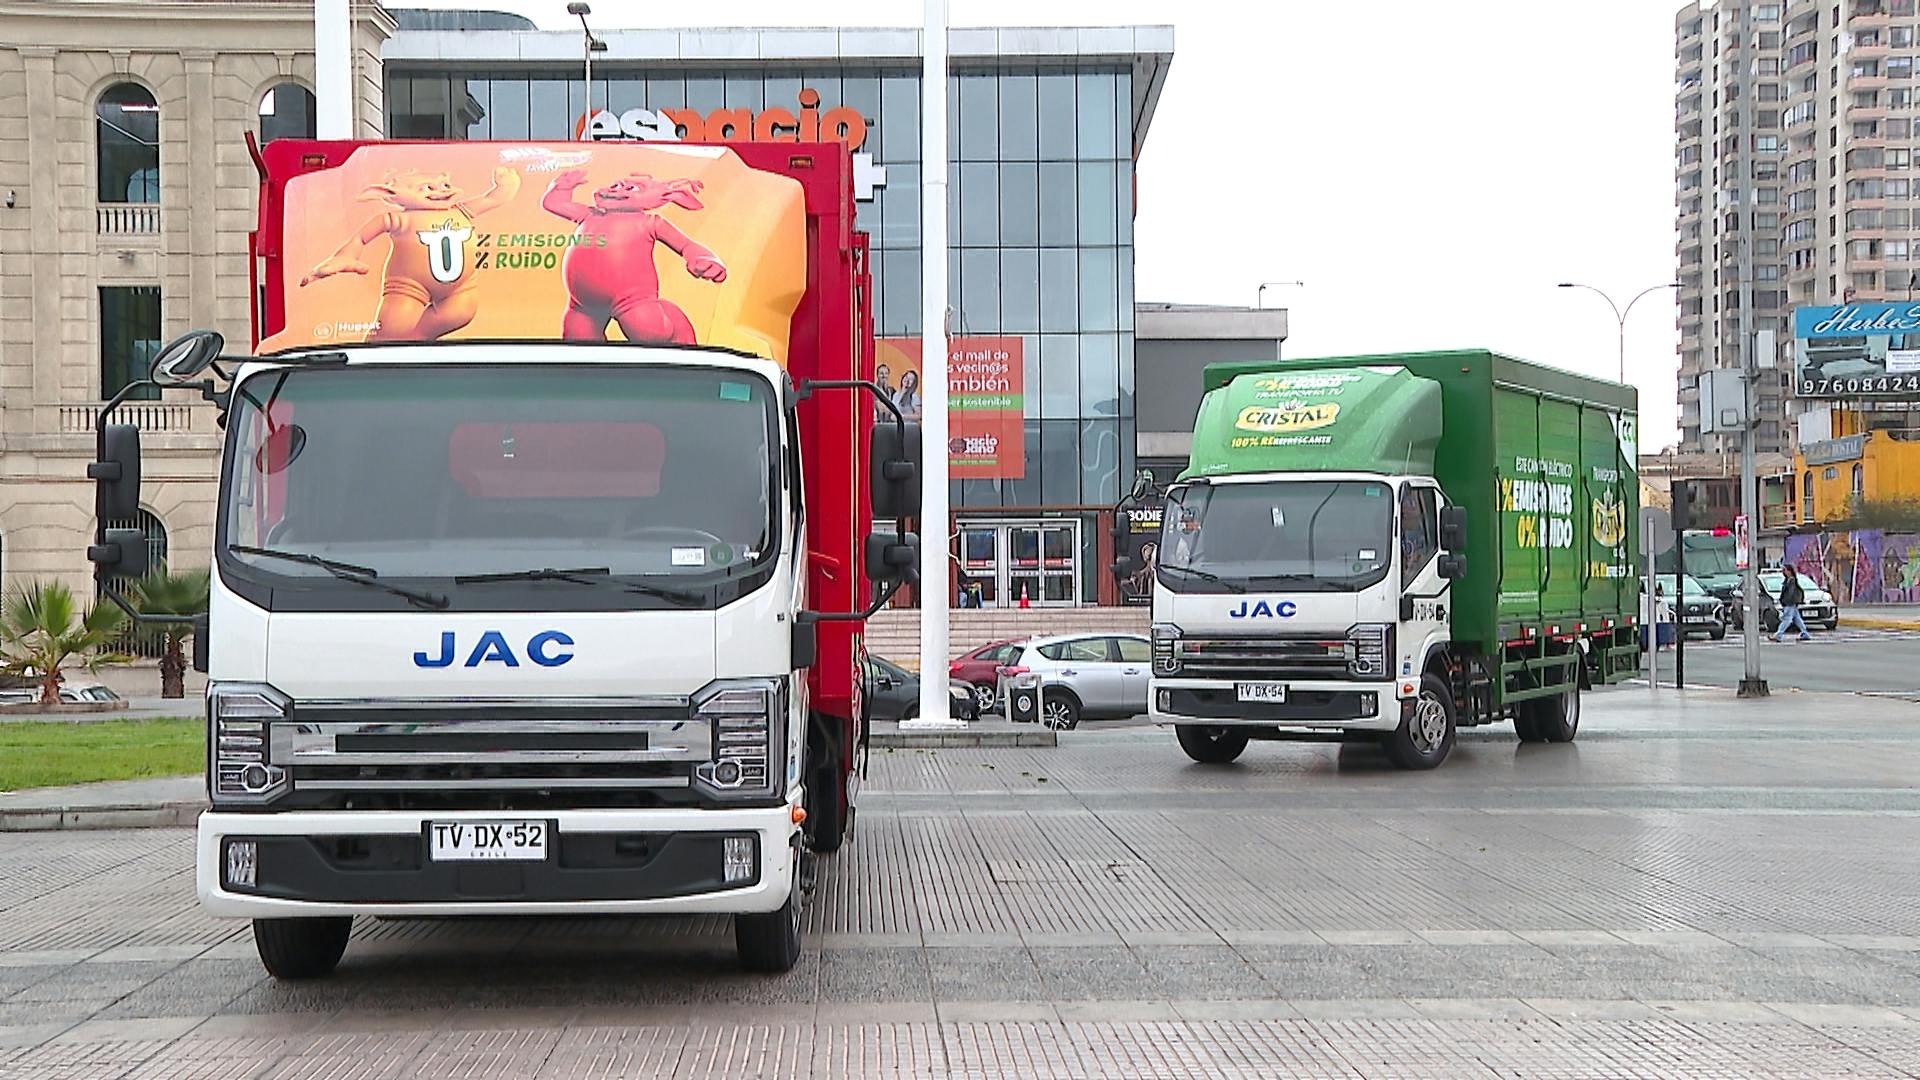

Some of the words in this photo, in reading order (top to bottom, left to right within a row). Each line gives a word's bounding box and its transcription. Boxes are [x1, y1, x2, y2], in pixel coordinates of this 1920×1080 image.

[952, 350, 963, 361] el
[966, 349, 991, 361] mall
[994, 349, 1009, 360] de
[950, 373, 1009, 391] mbién
[1803, 376, 1918, 394] 97608424
[1246, 408, 1329, 426] CRISTAL
[1230, 600, 1296, 618] JAC
[413, 631, 575, 667] JAC
